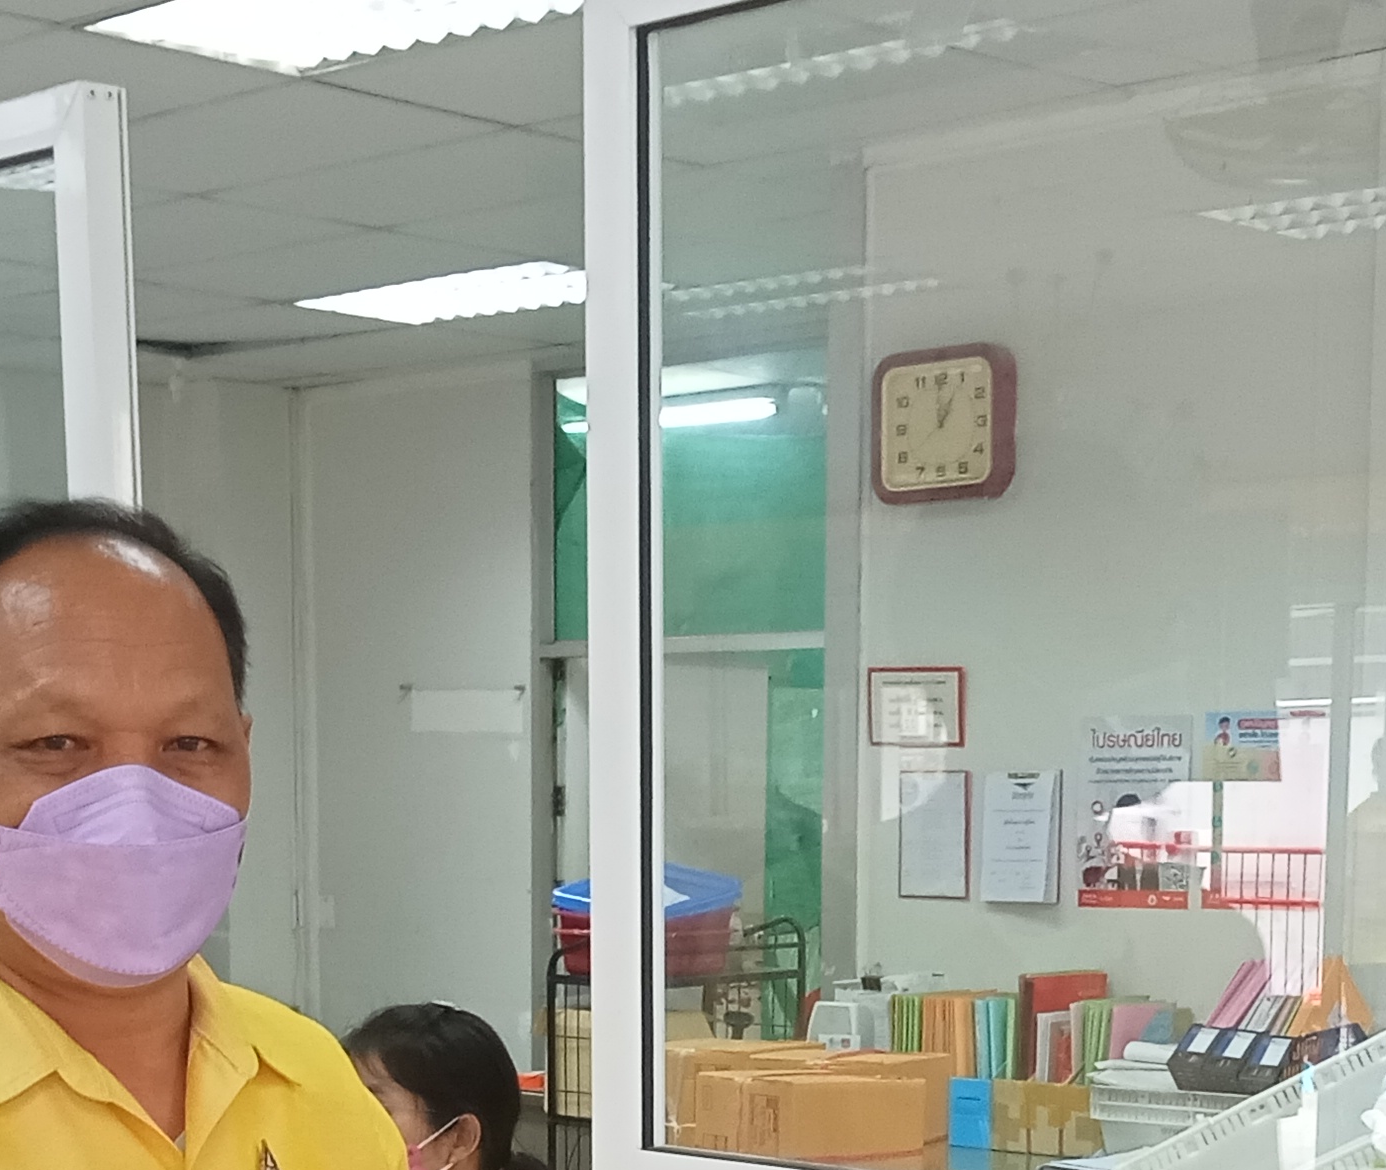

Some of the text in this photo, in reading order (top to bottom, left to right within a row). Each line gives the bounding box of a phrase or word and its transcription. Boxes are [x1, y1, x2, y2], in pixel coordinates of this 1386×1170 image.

[915, 376, 927, 389] 11
[959, 371, 966, 383] 1
[974, 386, 985, 399] 2
[973, 442, 984, 455] 4
[915, 466, 926, 476] 7
[958, 461, 969, 474] 5
[1090, 727, 1183, 749] ไปรษณีย์ไทย
